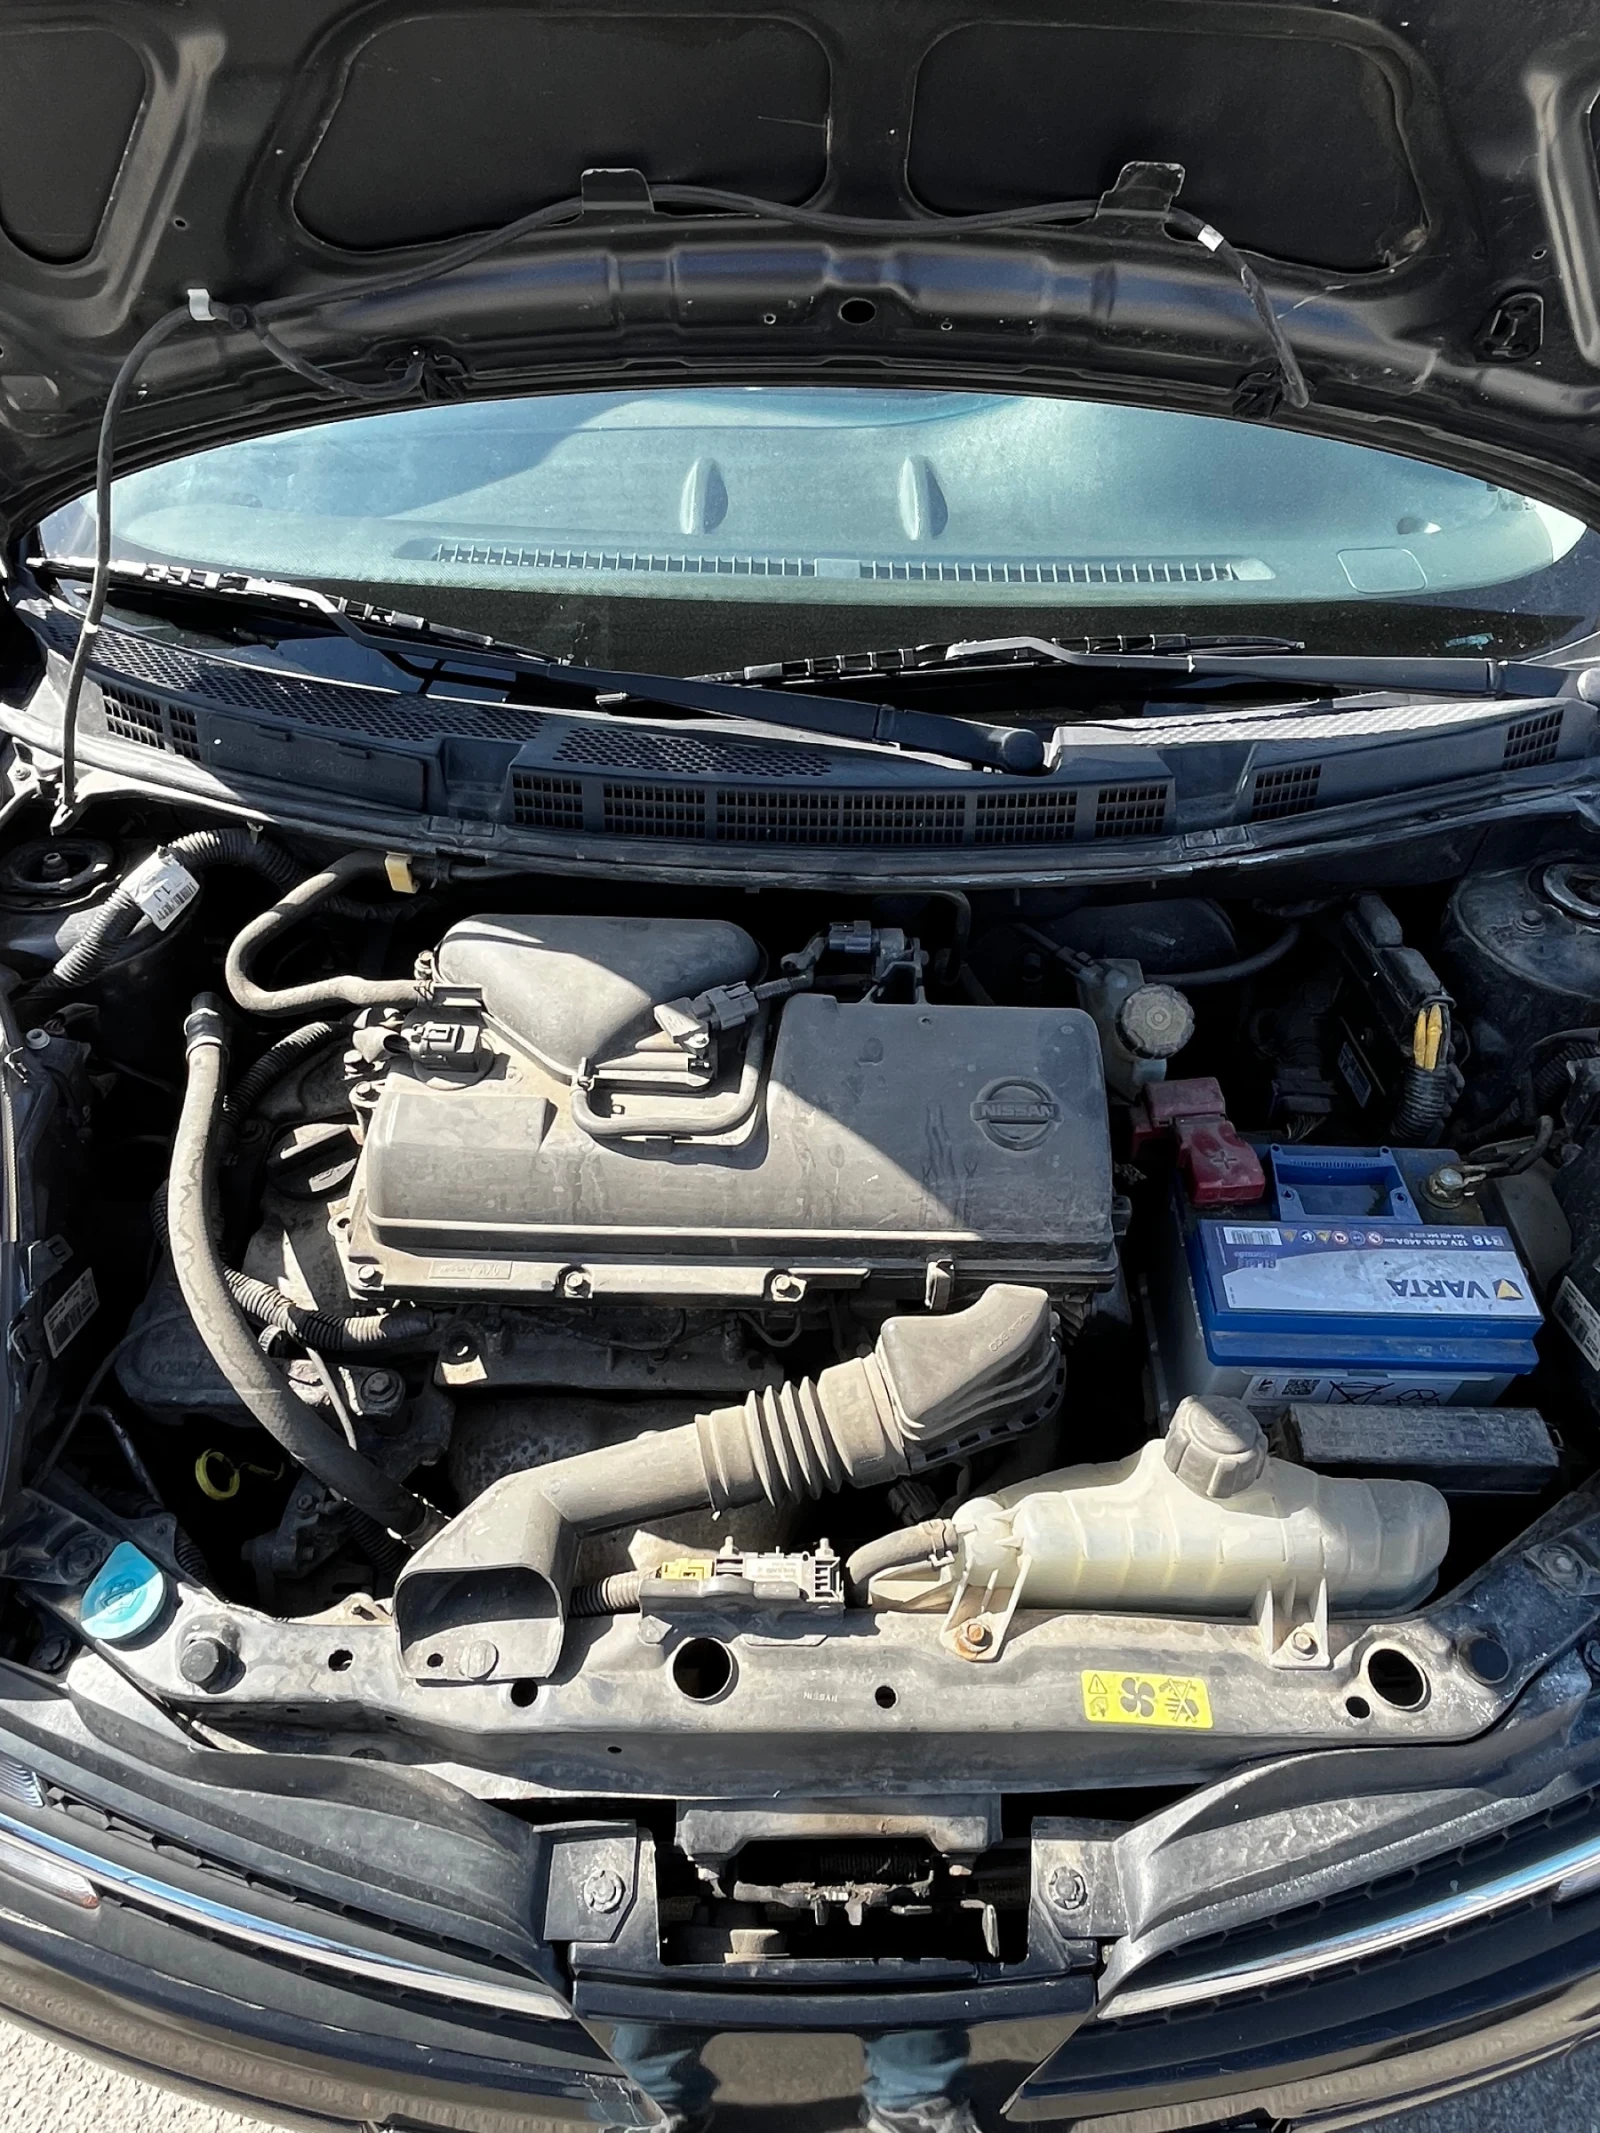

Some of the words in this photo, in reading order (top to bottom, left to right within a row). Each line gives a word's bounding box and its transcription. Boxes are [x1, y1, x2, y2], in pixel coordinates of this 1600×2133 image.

[981, 1103, 1055, 1118] NISSAN
[1450, 1239, 1469, 1247] 12V
[1471, 1234, 1505, 1247] B18
[1385, 1278, 1490, 1299] VARTA
